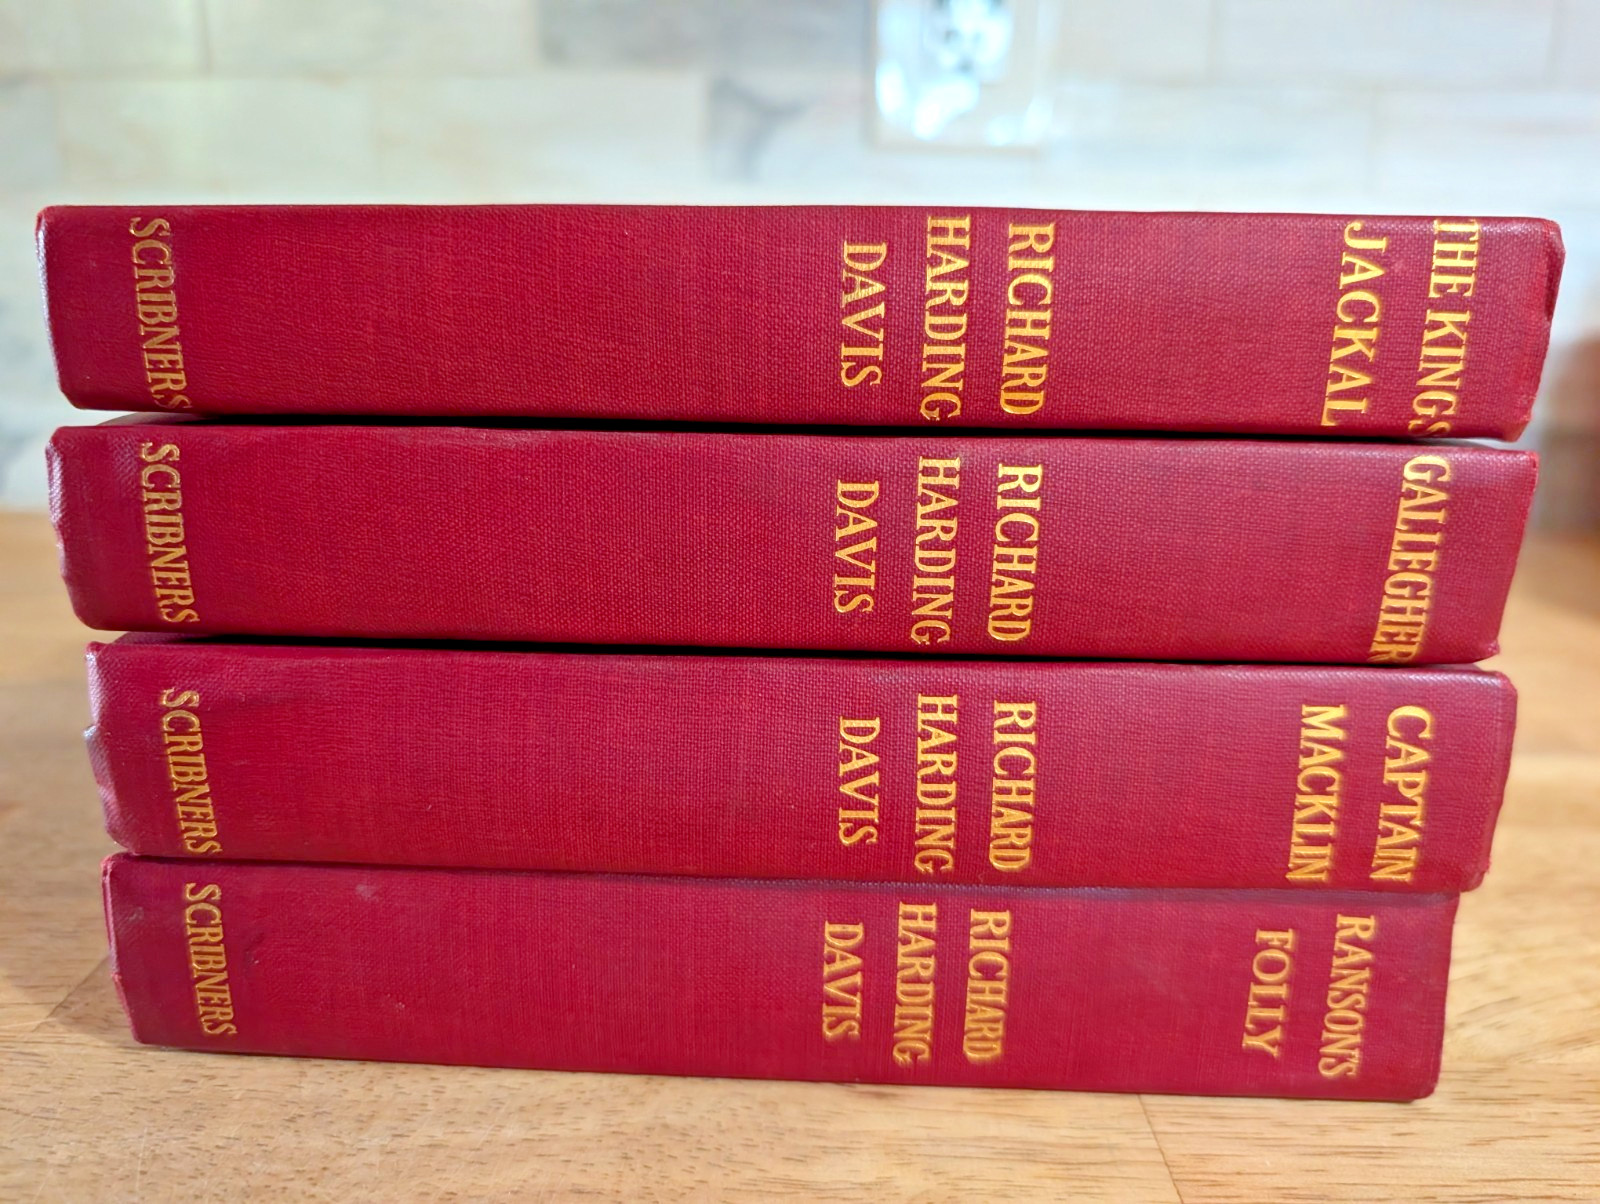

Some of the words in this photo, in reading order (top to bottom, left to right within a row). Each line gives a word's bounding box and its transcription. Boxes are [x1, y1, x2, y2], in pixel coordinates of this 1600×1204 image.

[129, 217, 191, 410] SCRIBNERS
[839, 241, 887, 389] DAVIS
[920, 215, 971, 421] HARDING
[1000, 223, 1056, 416] RICHARD
[1321, 221, 1389, 427] JACKAL
[1429, 218, 1481, 298] THE
[139, 441, 201, 624] SCRIBNERS
[833, 480, 880, 614] DAVIS
[911, 456, 963, 646] HARDING
[988, 464, 1043, 642] RICHARD
[1369, 454, 1452, 660] GALLEGHER
[160, 688, 222, 855] SCRIBNERS
[838, 716, 881, 848] DAVIS
[914, 694, 959, 874] HARDING
[989, 700, 1037, 871] RICHARD
[1286, 704, 1348, 882] MACKLIN
[1370, 704, 1434, 882] CAPTAIN
[184, 882, 238, 1036] SCRIBNERS
[822, 922, 865, 1040] DAVIS
[892, 902, 938, 1065] HARDING
[963, 909, 1011, 1061] RICHARD
[1241, 929, 1295, 1058] FOLLY
